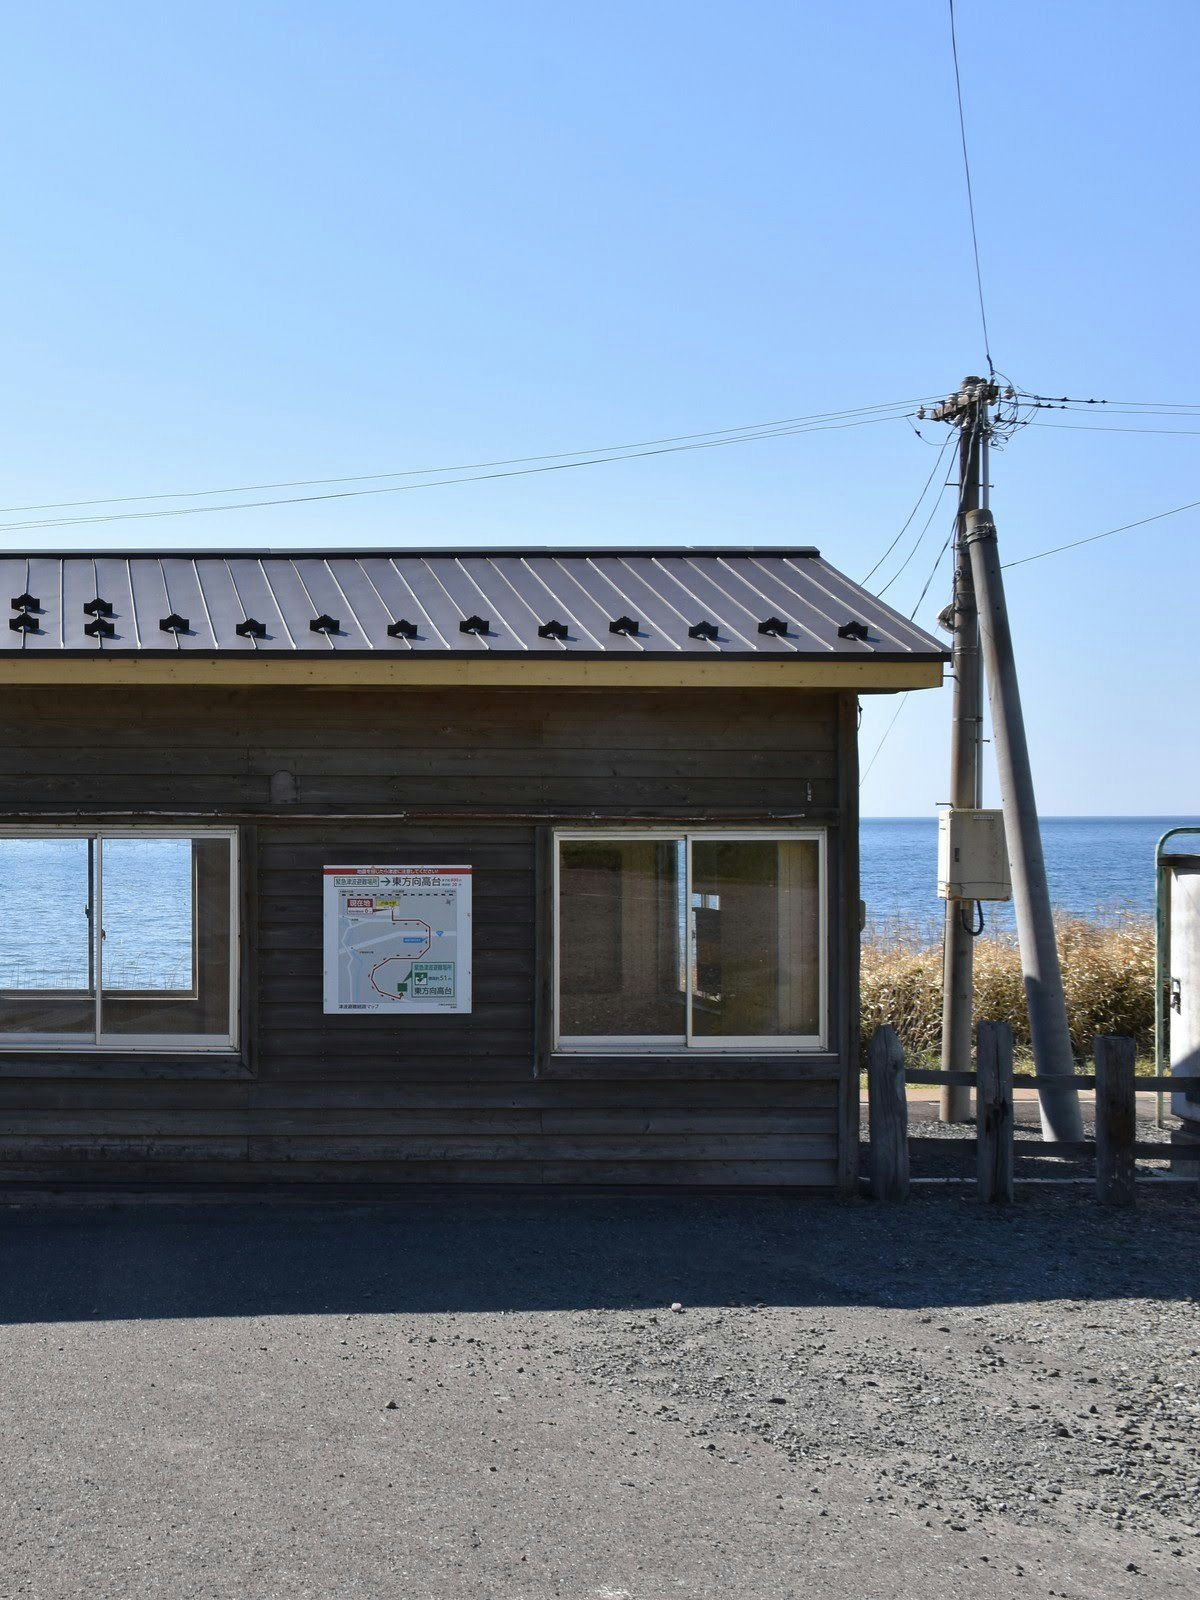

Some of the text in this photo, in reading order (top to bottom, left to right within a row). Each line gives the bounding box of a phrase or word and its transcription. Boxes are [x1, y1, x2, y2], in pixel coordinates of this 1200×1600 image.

[392, 877, 441, 886] 東方向高台
